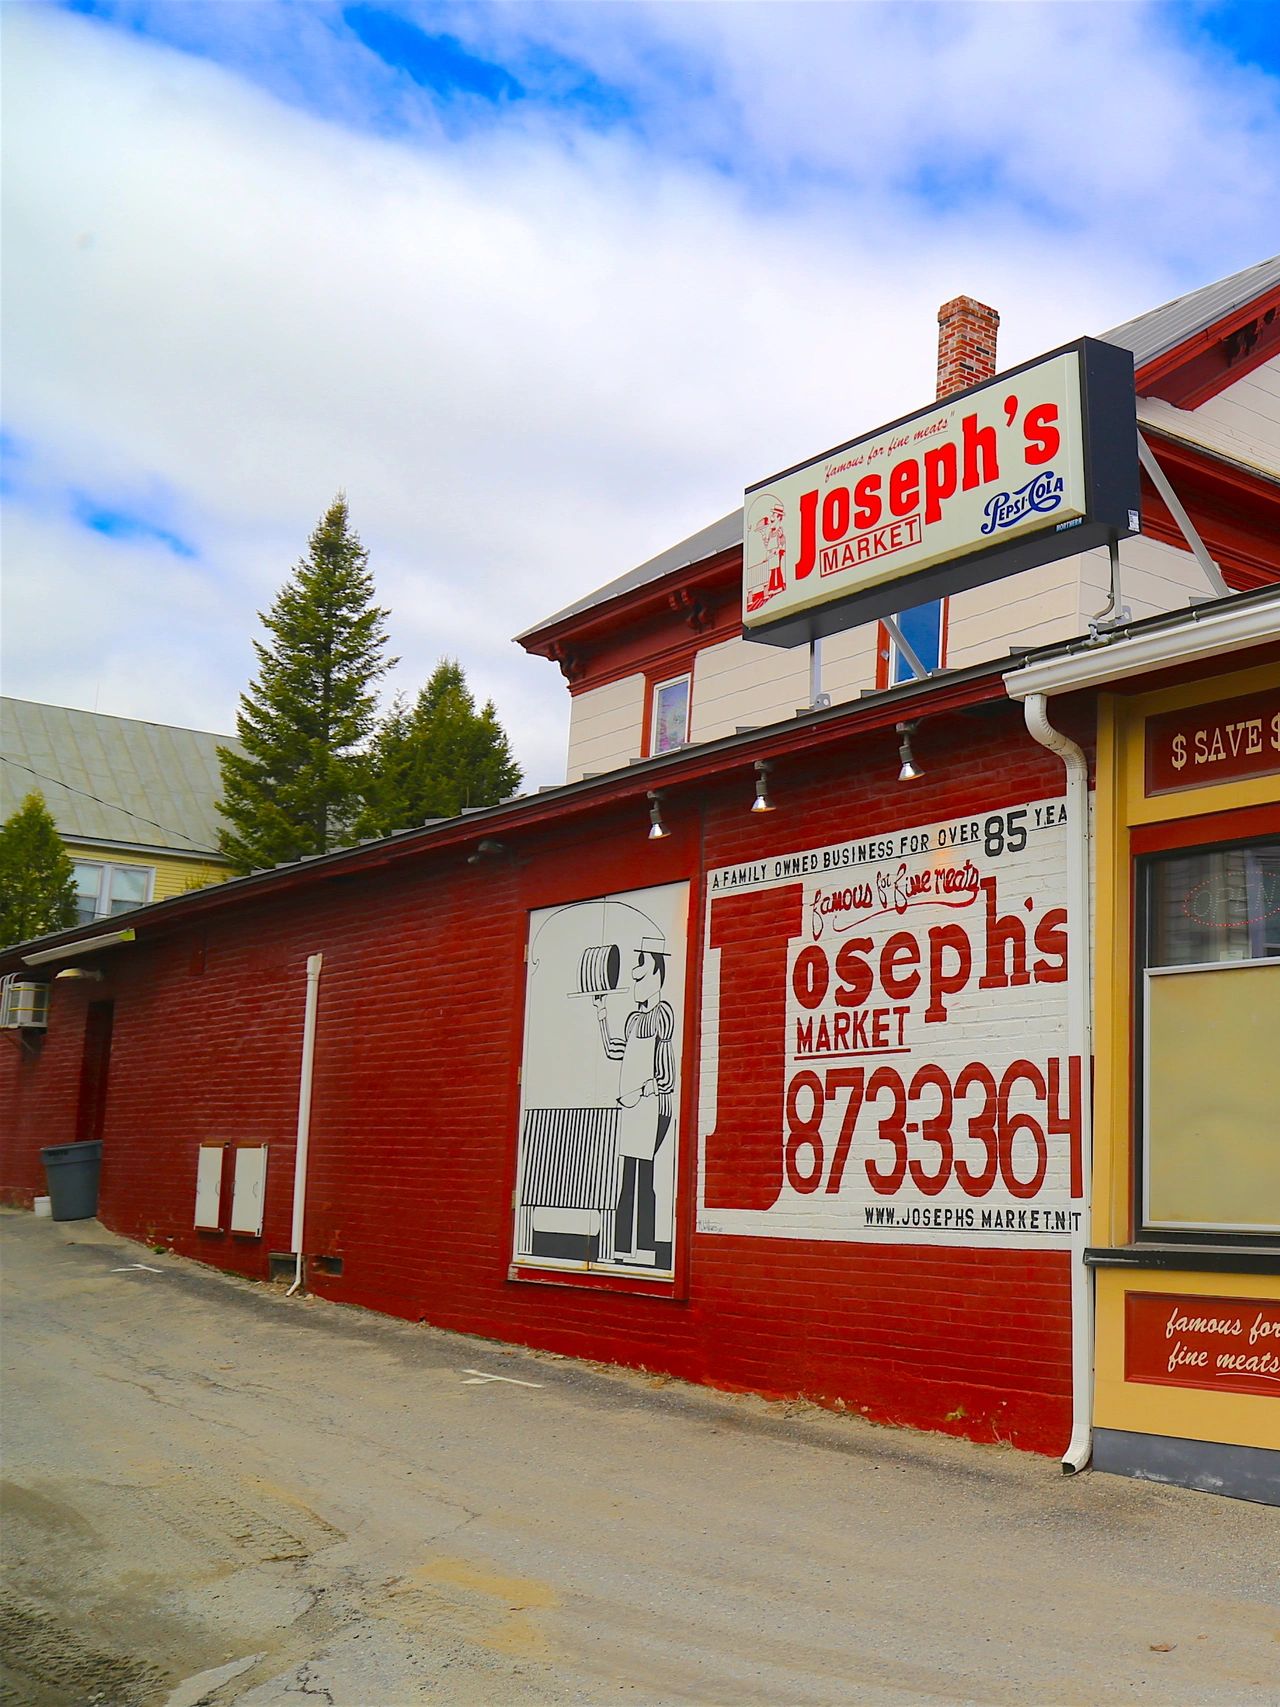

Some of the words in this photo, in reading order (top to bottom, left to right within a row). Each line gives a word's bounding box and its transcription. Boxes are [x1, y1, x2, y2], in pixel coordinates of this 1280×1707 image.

[867, 446, 884, 465] for
[888, 435, 910, 456] fine
[795, 395, 1061, 580] Joseph's
[823, 521, 920, 573] MARKET
[1194, 718, 1262, 764] SAVE
[713, 873, 719, 889] A
[723, 863, 767, 887] FAMILY
[775, 853, 818, 878] OWNED
[824, 841, 893, 869] BUSINESS
[900, 833, 929, 854] FOR
[938, 822, 979, 846] OVER
[984, 809, 1027, 857] 85
[1035, 804, 1067, 826] YEA
[809, 882, 873, 941] famous
[876, 871, 892, 908] for
[894, 863, 931, 914] fine
[704, 876, 1068, 1211] Joseph's
[797, 1006, 910, 1054] MARKET
[785, 1055, 1084, 1199] 873-3364
[864, 1206, 975, 1227] WWW.JOSEPHS
[981, 1209, 1082, 1232] MARKET.NT
[1166, 1307, 1243, 1339] famous
[1167, 1341, 1209, 1372] fine
